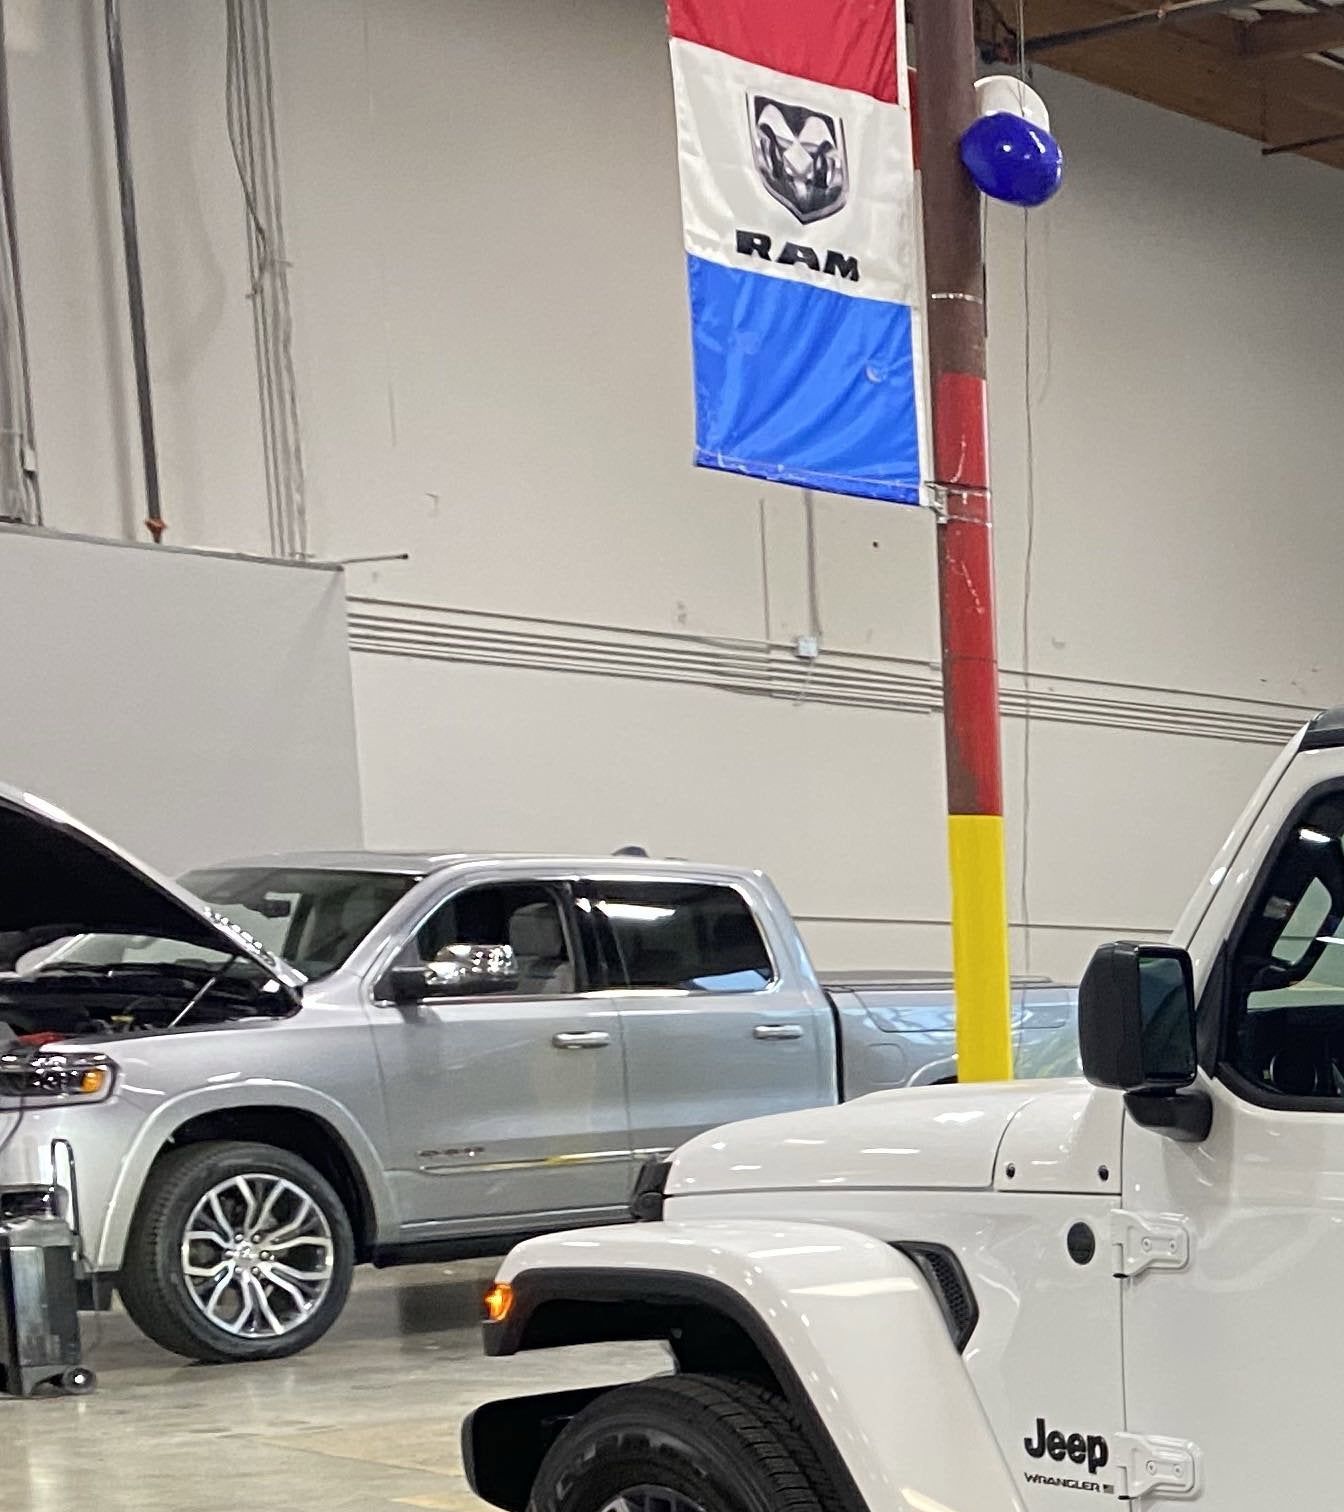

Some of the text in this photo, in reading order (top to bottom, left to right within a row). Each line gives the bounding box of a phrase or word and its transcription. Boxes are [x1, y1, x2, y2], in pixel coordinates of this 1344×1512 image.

[737, 230, 860, 281] RAM
[1024, 1418, 1109, 1474] Jeep
[1024, 1472, 1100, 1492] WRANGLER
